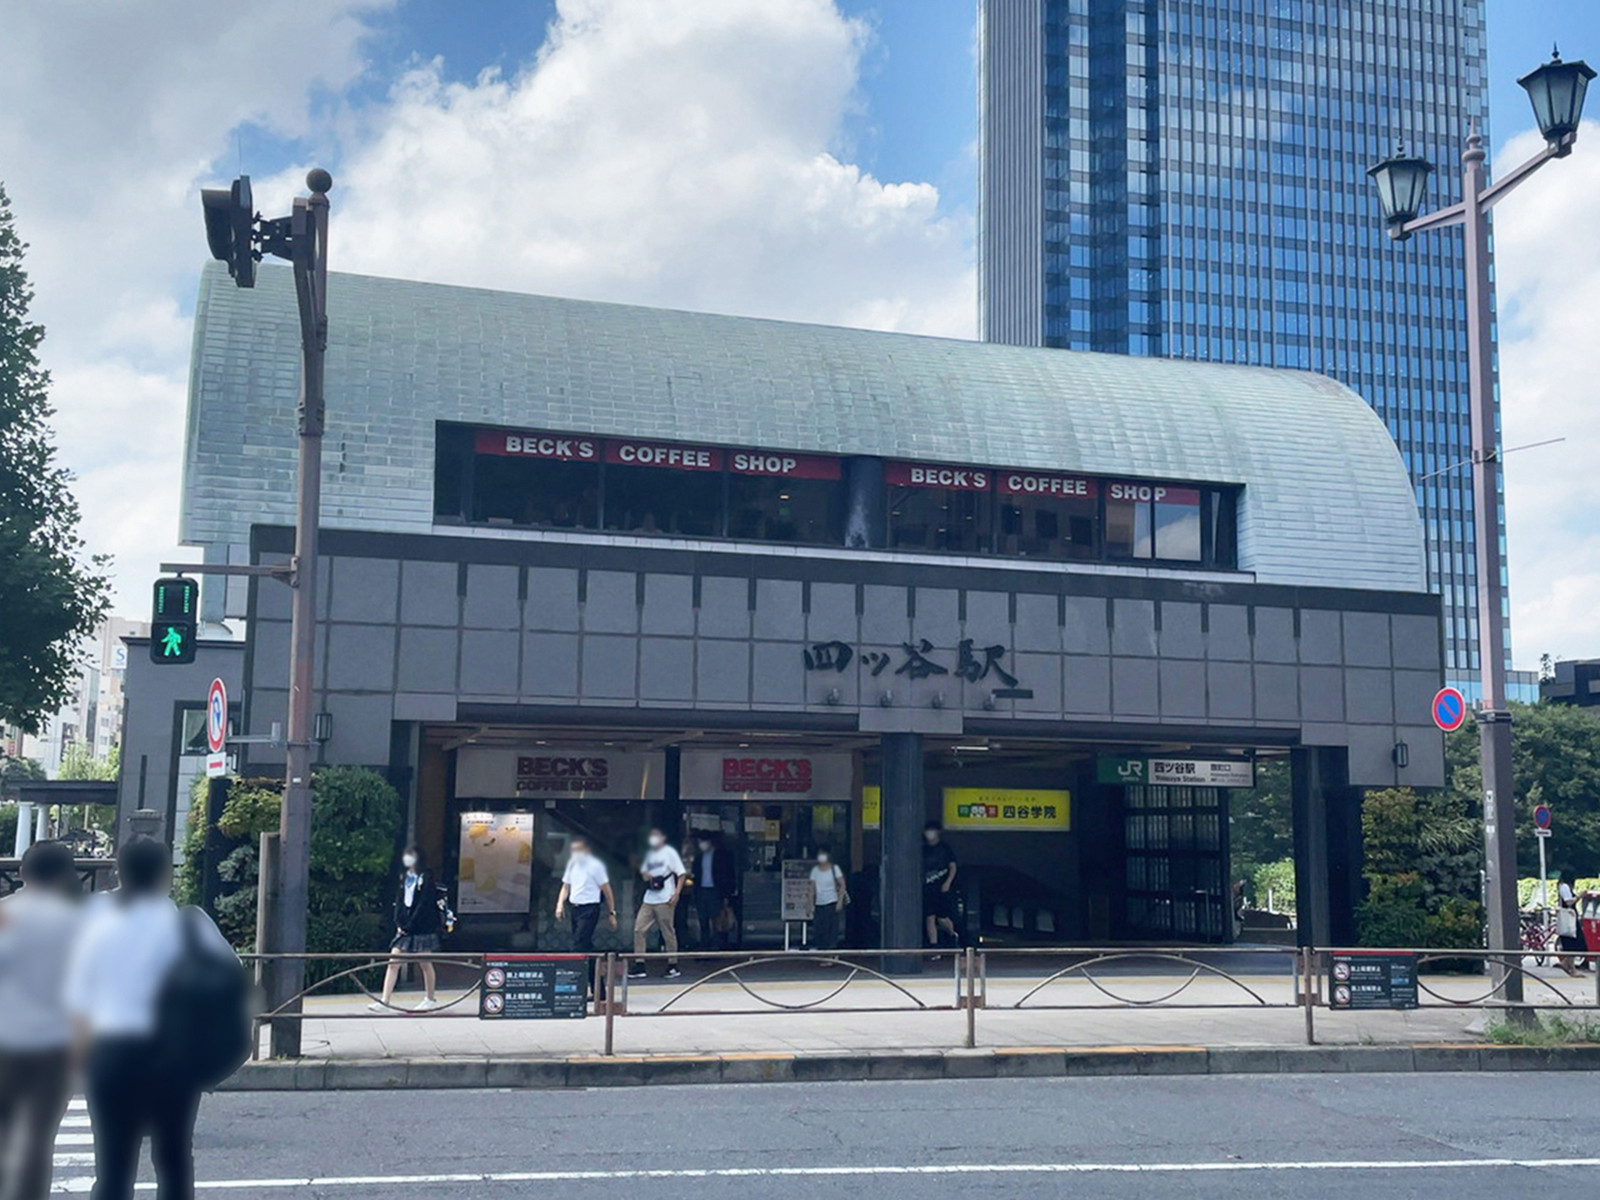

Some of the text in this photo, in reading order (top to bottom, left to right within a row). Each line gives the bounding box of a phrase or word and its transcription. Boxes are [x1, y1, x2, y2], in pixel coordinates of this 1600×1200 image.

[506, 436, 796, 473] BECK'S COFFEE SHOP
[911, 468, 1167, 501] BECK'S COFFEE SHOP
[803, 639, 1019, 688] 四ツ谷駅
[1118, 761, 1142, 776] JR
[1154, 762, 1196, 774] 四ツ谷駅
[1003, 805, 1056, 819] 四谷学院
